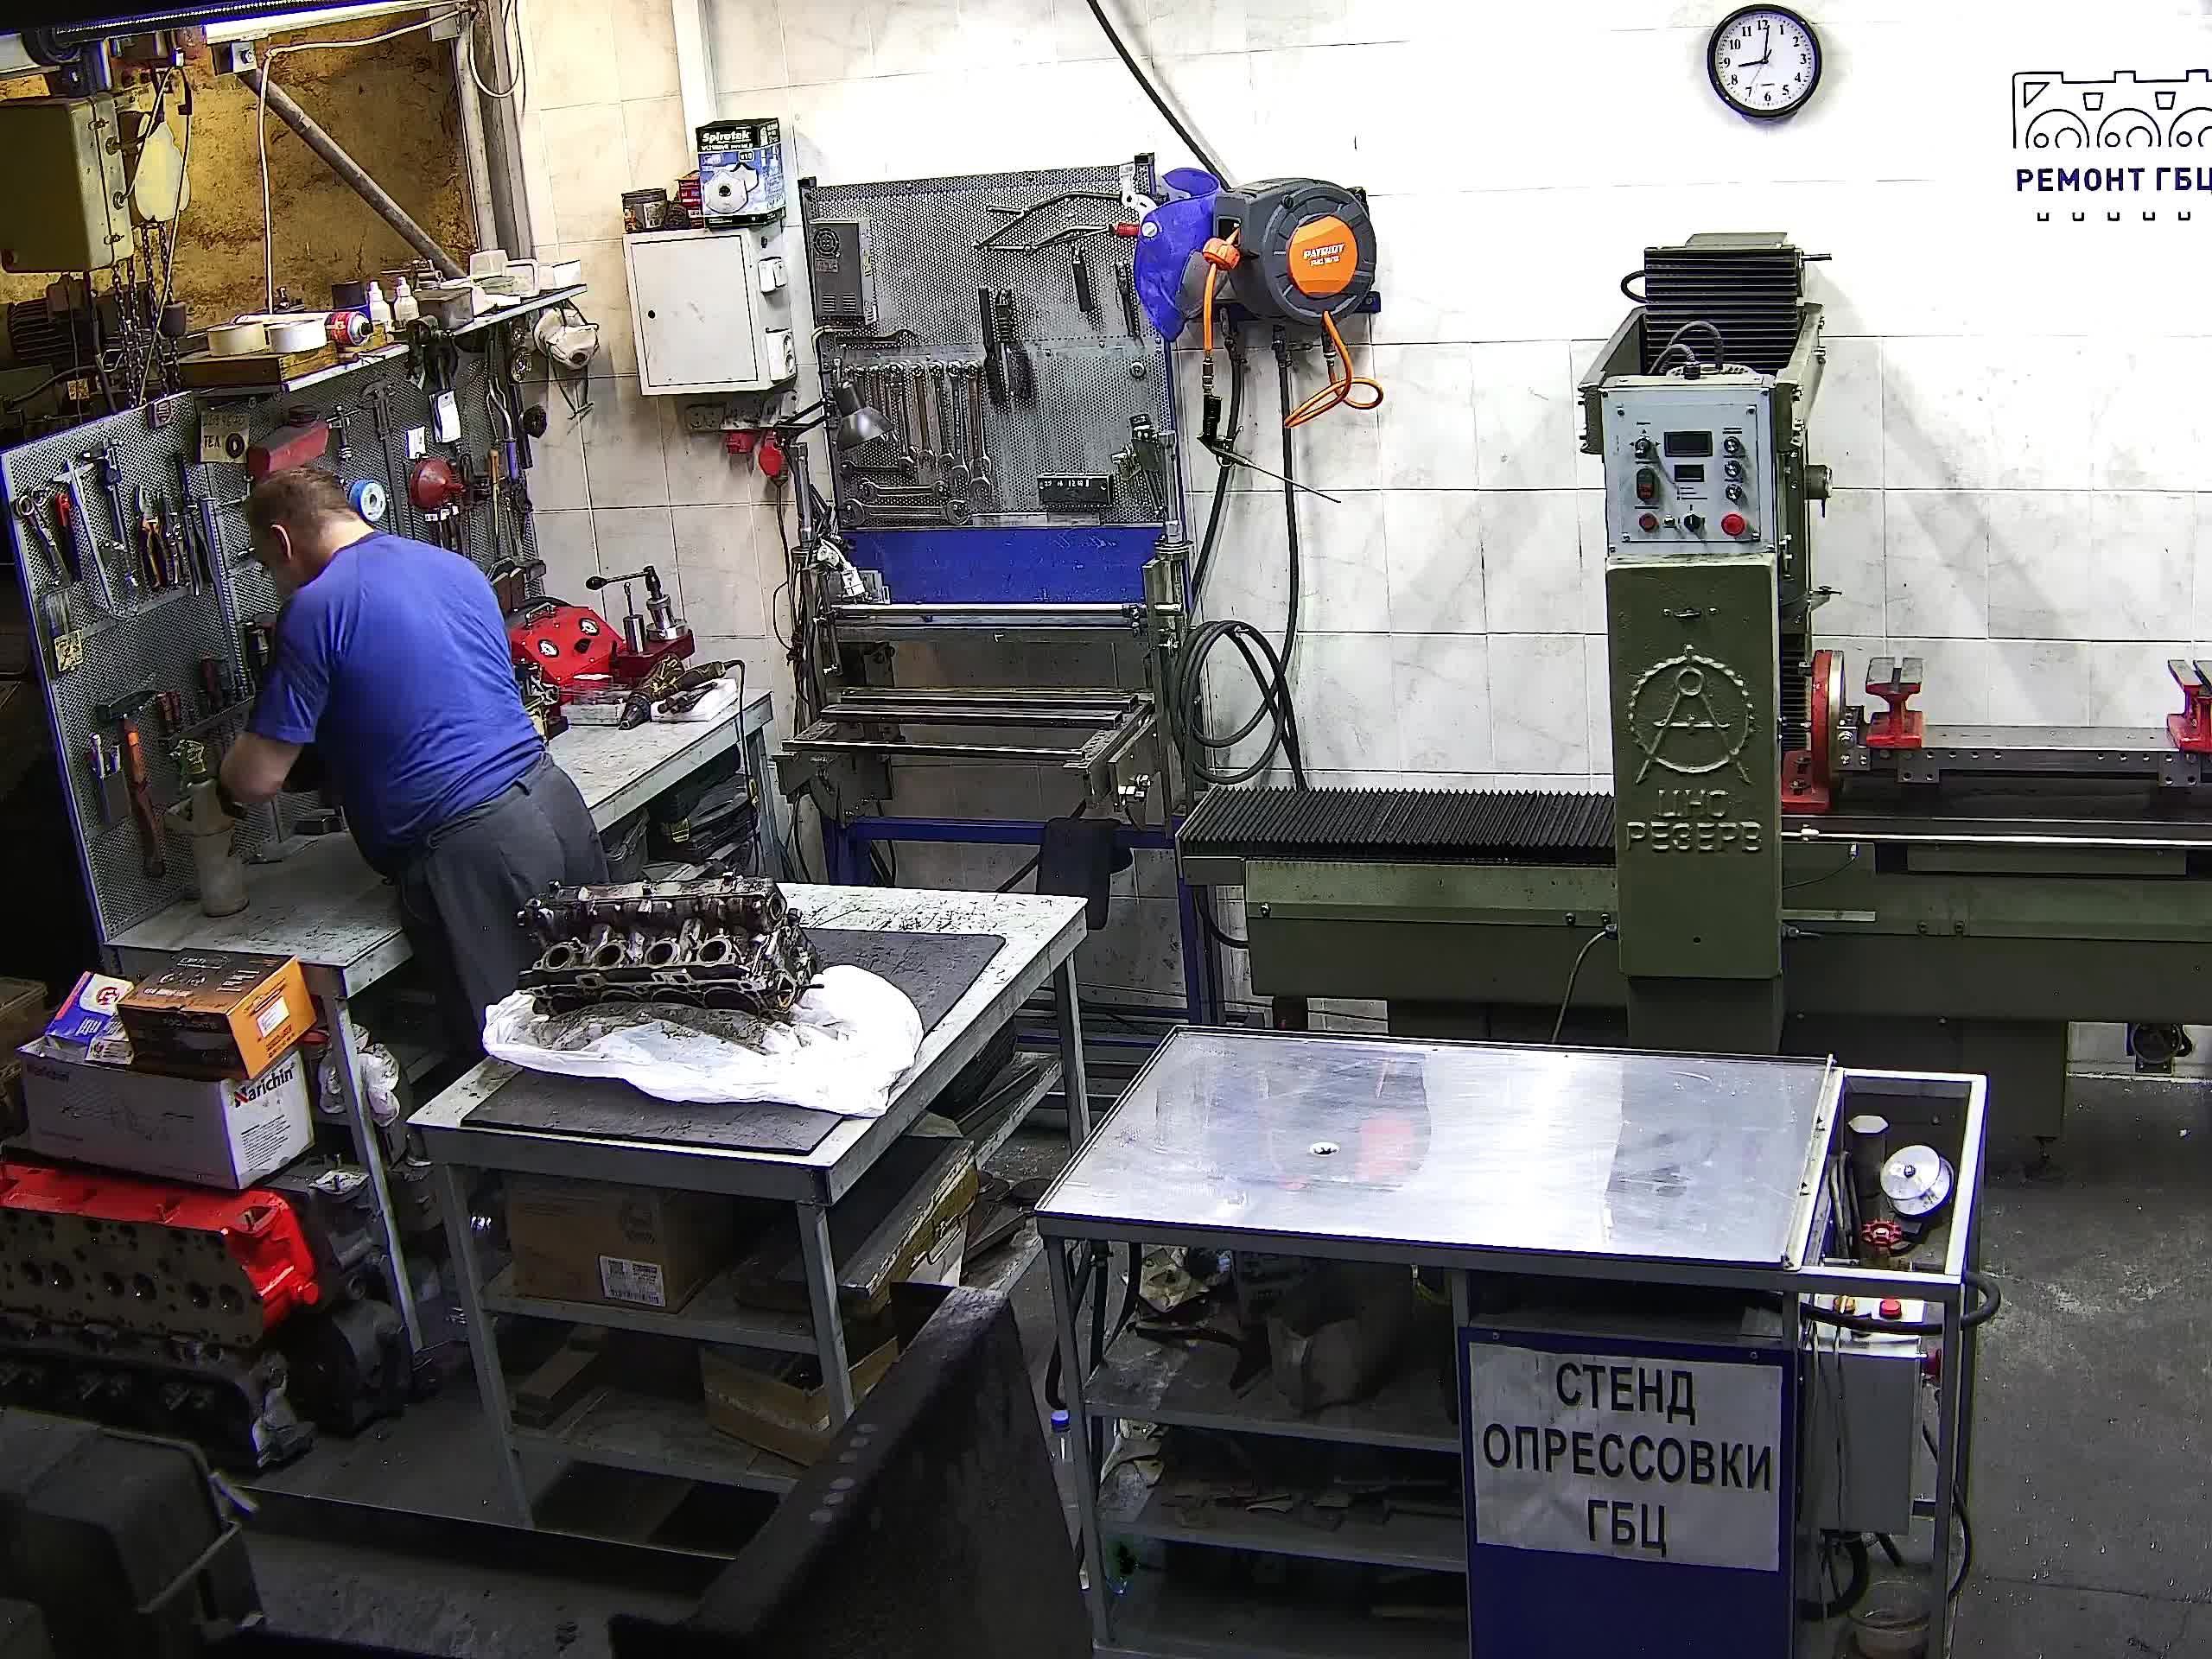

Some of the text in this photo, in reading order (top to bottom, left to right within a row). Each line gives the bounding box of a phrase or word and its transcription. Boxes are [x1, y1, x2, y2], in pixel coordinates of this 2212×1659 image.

[1742, 25, 1752, 37] 11
[1757, 19, 1769, 31] 12
[1729, 38, 1741, 50] 10
[1792, 35, 1800, 48] 2
[1723, 57, 1731, 68] 9
[1800, 53, 1807, 65] 3
[1730, 73, 1738, 86] 8
[1794, 72, 1802, 83] 4
[1745, 86, 1752, 98] 7
[1782, 84, 1789, 96] 5
[1764, 91, 1771, 102] 6
[2016, 168, 2145, 192] РЕМОНТ
[1303, 243, 1345, 260] PATRIOT
[1626, 820, 1763, 852] РЕЗЕРВ
[1555, 1361, 1696, 1427] СТЕНД
[1483, 1422, 1772, 1492] ОПРЕССОВКИ
[1586, 1498, 1668, 1559] ГБЦ
